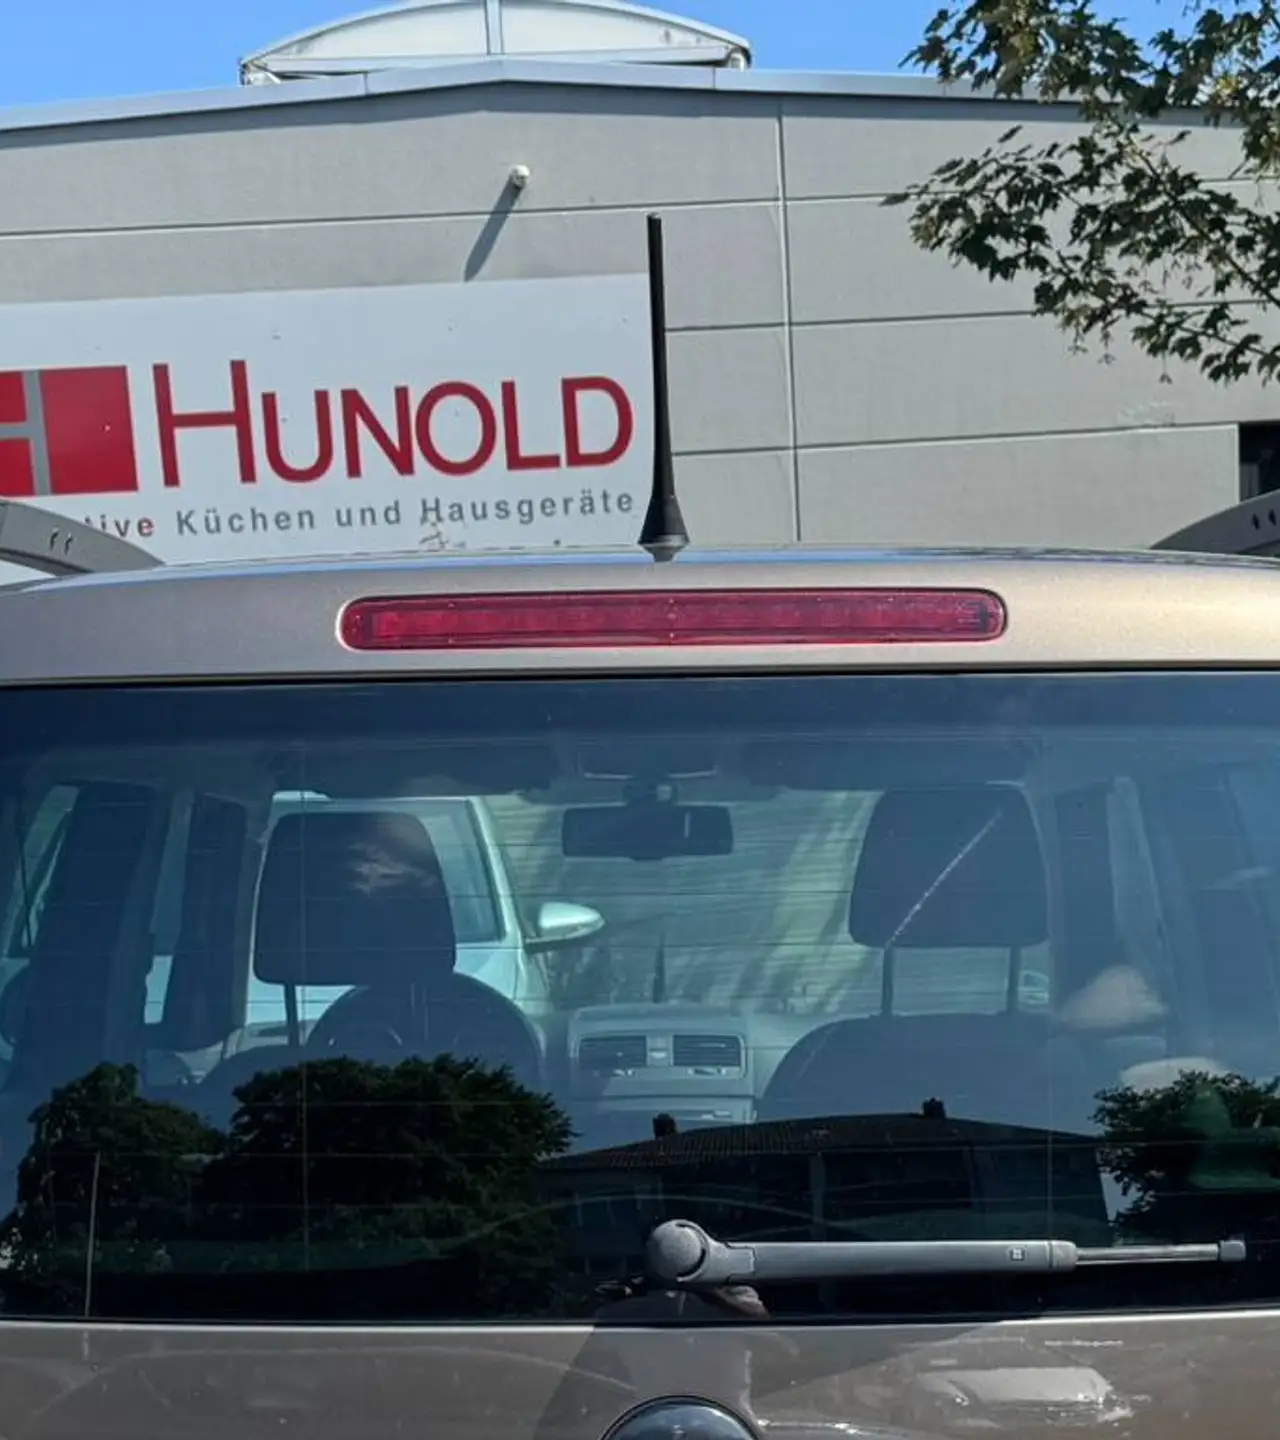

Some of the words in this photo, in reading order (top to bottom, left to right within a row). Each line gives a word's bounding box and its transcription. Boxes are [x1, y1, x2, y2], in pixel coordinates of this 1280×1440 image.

[153, 359, 634, 488] HUNOLD
[176, 507, 315, 536] Küchen
[335, 500, 401, 528] und
[420, 489, 634, 526] Hausgeräte
